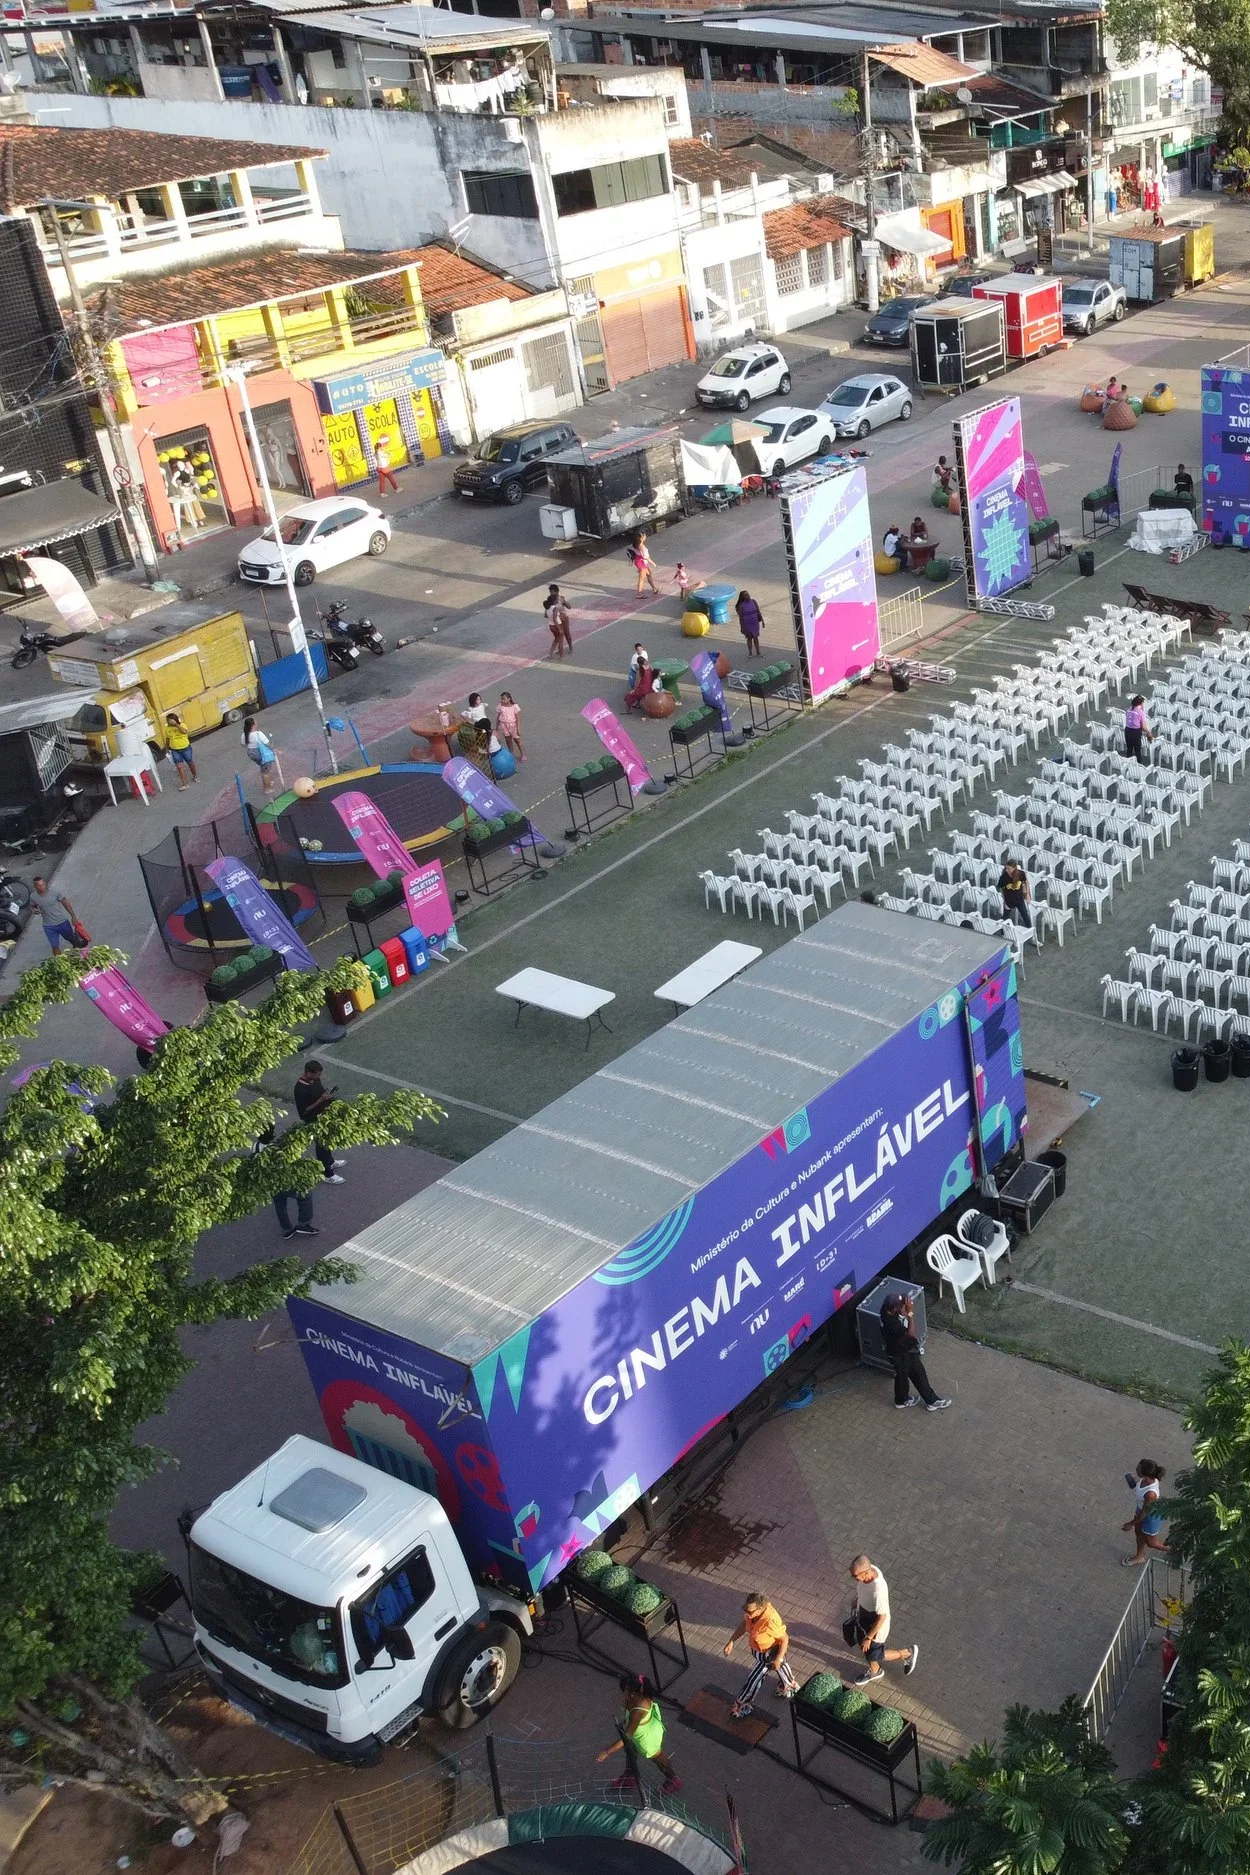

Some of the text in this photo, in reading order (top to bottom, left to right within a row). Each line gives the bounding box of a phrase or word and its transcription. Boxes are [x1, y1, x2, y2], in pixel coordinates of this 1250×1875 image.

[414, 360, 445, 376] ESCOLA
[368, 411, 398, 432] SCOLA
[327, 425, 356, 446] AUTO
[1228, 435, 1237, 443] O
[983, 497, 1014, 519] INFLÁVEL
[985, 488, 1009, 507] CINEMA
[408, 874, 442, 896] SELETIVA
[409, 868, 438, 887] COLETA
[413, 891, 425, 901] DE
[424, 883, 440, 897] LIXO
[690, 1229, 741, 1274] Ministério
[740, 1217, 755, 1234] da
[755, 1188, 791, 1220] Cultura
[790, 1181, 798, 1191] e
[797, 1149, 833, 1185] Nubank
[583, 1079, 971, 1426] CINEMA INFLÁVEL
[305, 1327, 482, 1420] CINEMA INFLÁVEL
